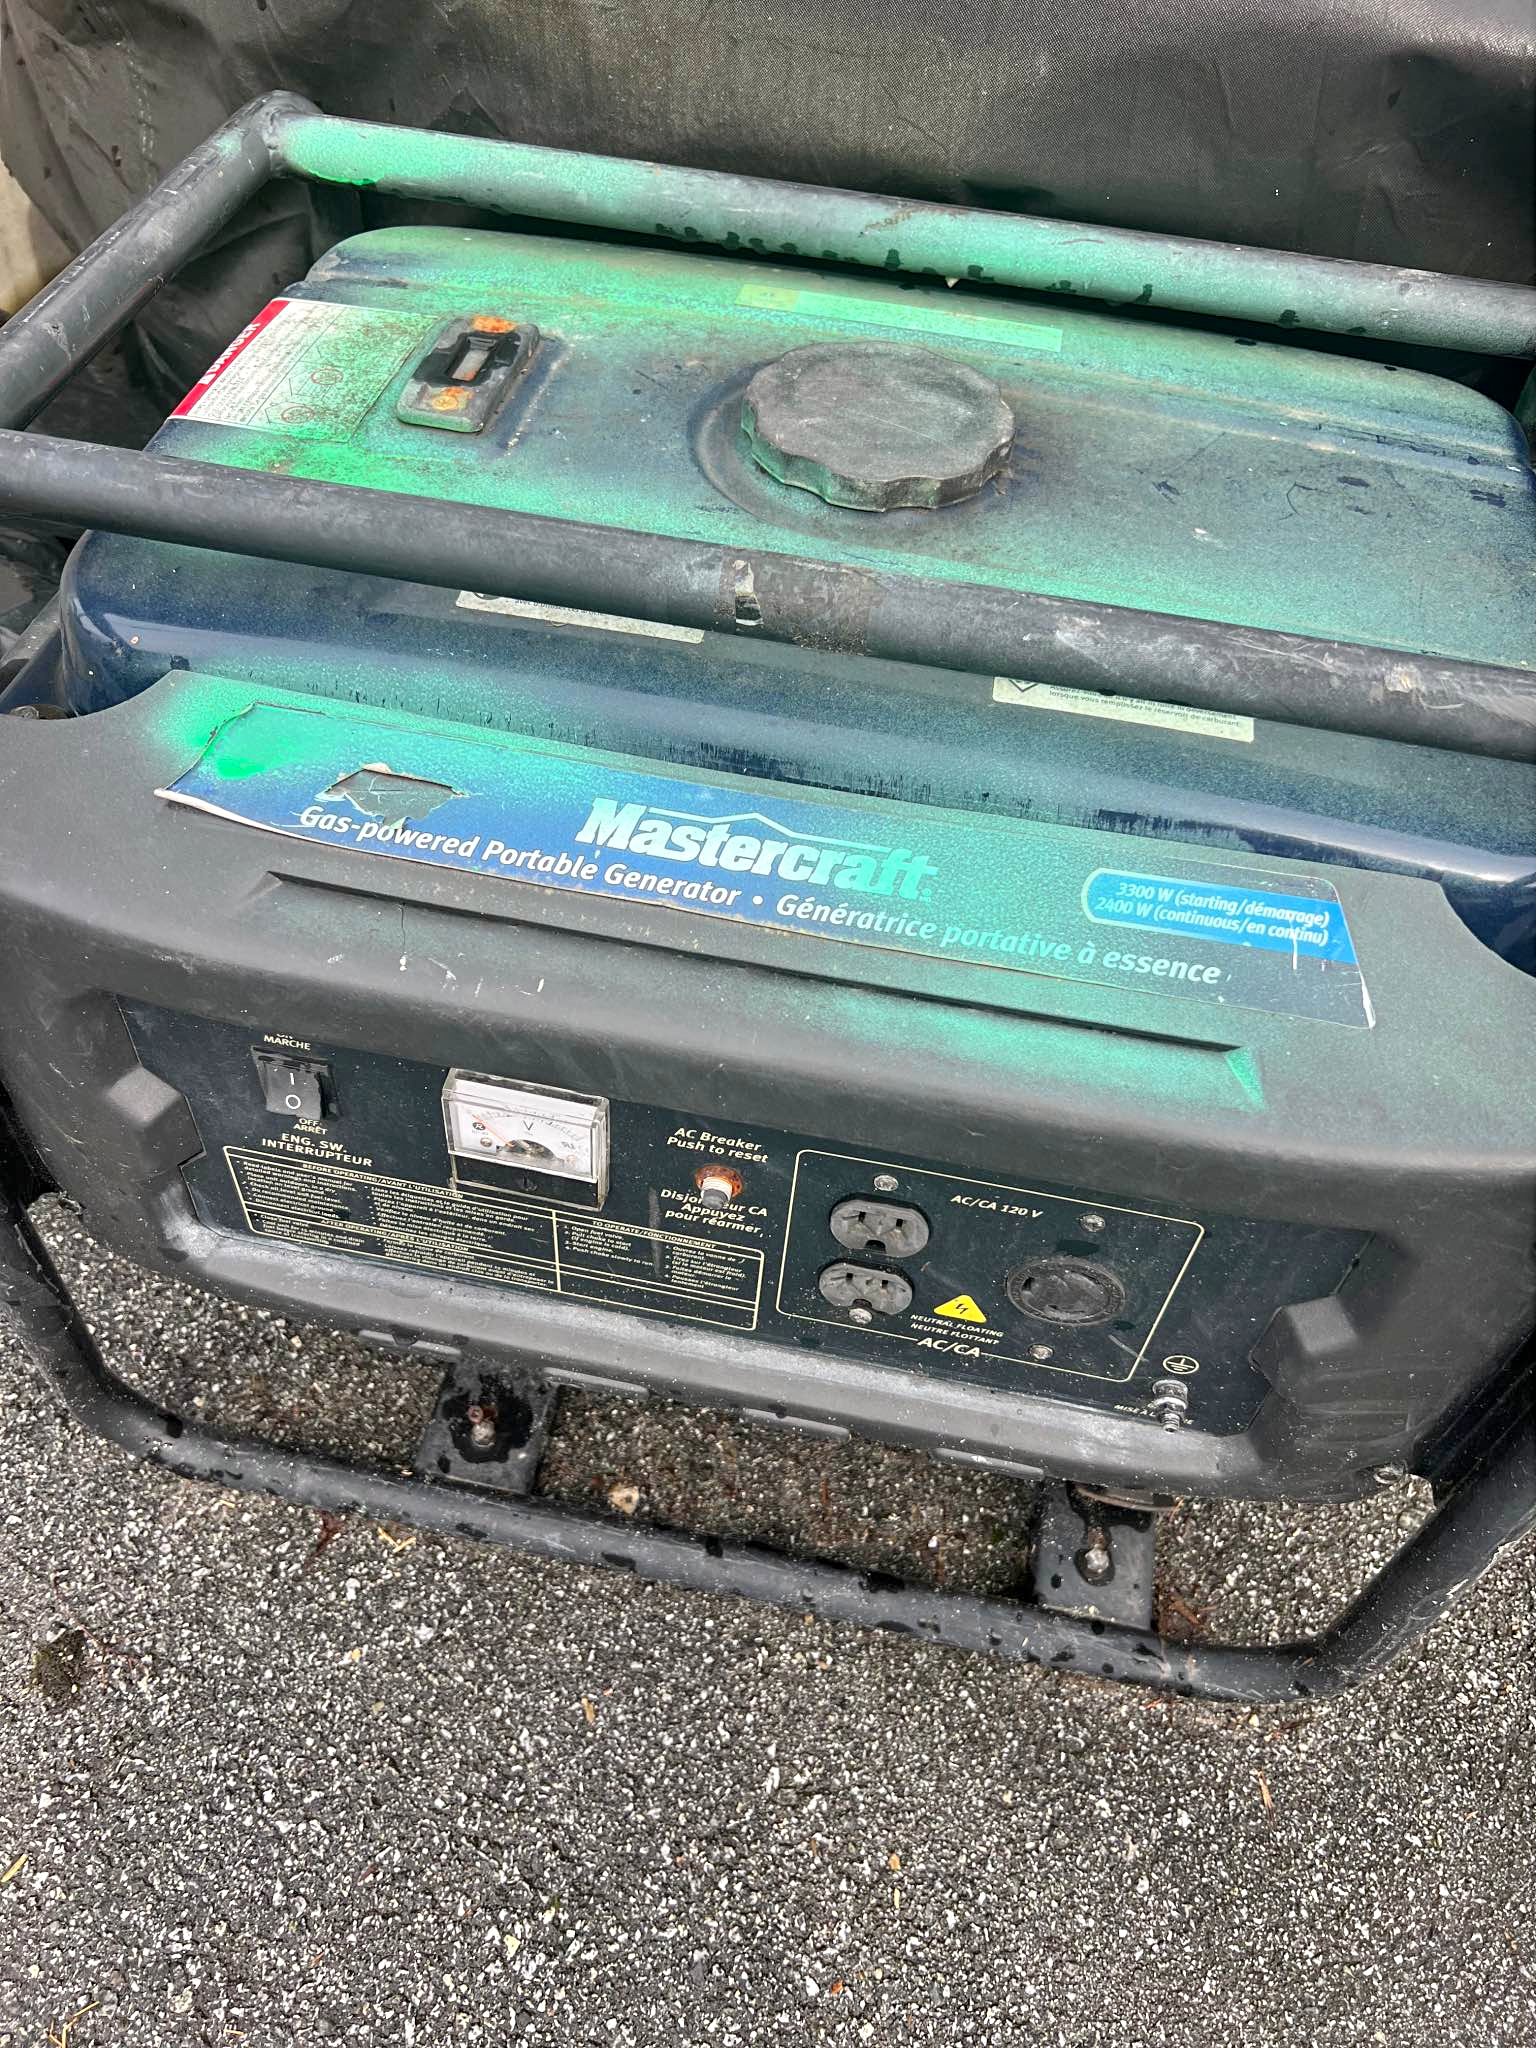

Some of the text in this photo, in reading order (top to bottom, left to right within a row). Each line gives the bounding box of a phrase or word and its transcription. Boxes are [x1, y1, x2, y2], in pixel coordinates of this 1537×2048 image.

[205, 322, 261, 375] DANGER
[575, 797, 938, 900] Mastercraft
[300, 804, 1221, 985] Gas-powered Portable Generator Génératrice portative à essence
[1118, 881, 1330, 928] 3300 W (starting/démarrage)
[1098, 897, 1329, 947] 2400 W (continuous/en continu)
[263, 1034, 311, 1051] MARCHE
[293, 1123, 328, 1135] ARRÊT
[299, 1117, 320, 1127] OFF
[281, 1132, 347, 1153] ENG. SW.
[667, 1136, 769, 1163] Push to reset
[674, 1127, 762, 1152] AC Breaker
[262, 1138, 373, 1167] INTERRUPTEUR
[302, 1163, 330, 1173] BEFORE
[665, 1210, 700, 1222] pour
[681, 1203, 746, 1222] Appuyez
[748, 1206, 768, 1217] CA
[950, 1194, 1043, 1219] AC/CA 120 V
[910, 1314, 1005, 1338] NEUTRAL FLOATING
[910, 1322, 1000, 1345] NEUTRE FLOTTANT
[916, 1336, 983, 1358] AC/CA
